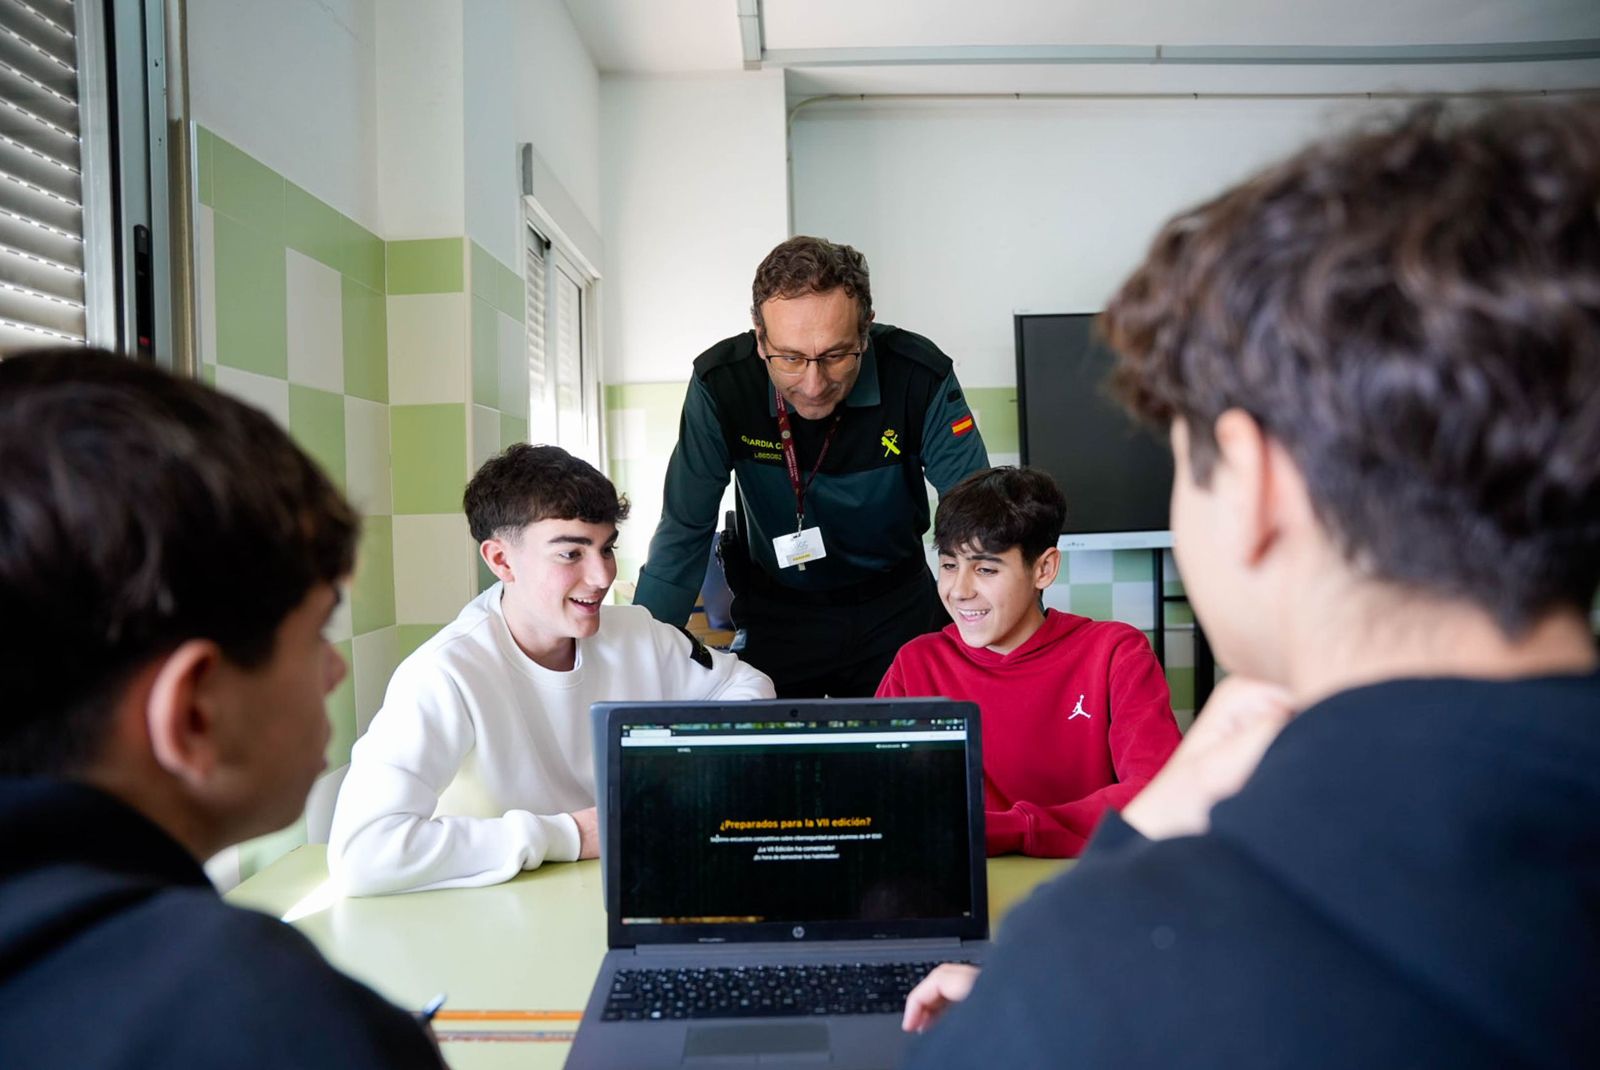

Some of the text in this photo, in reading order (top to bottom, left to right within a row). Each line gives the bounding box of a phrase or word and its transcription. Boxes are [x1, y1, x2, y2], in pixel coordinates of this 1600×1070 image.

[720, 816, 872, 831] ¿Preparados para la VII edición?
